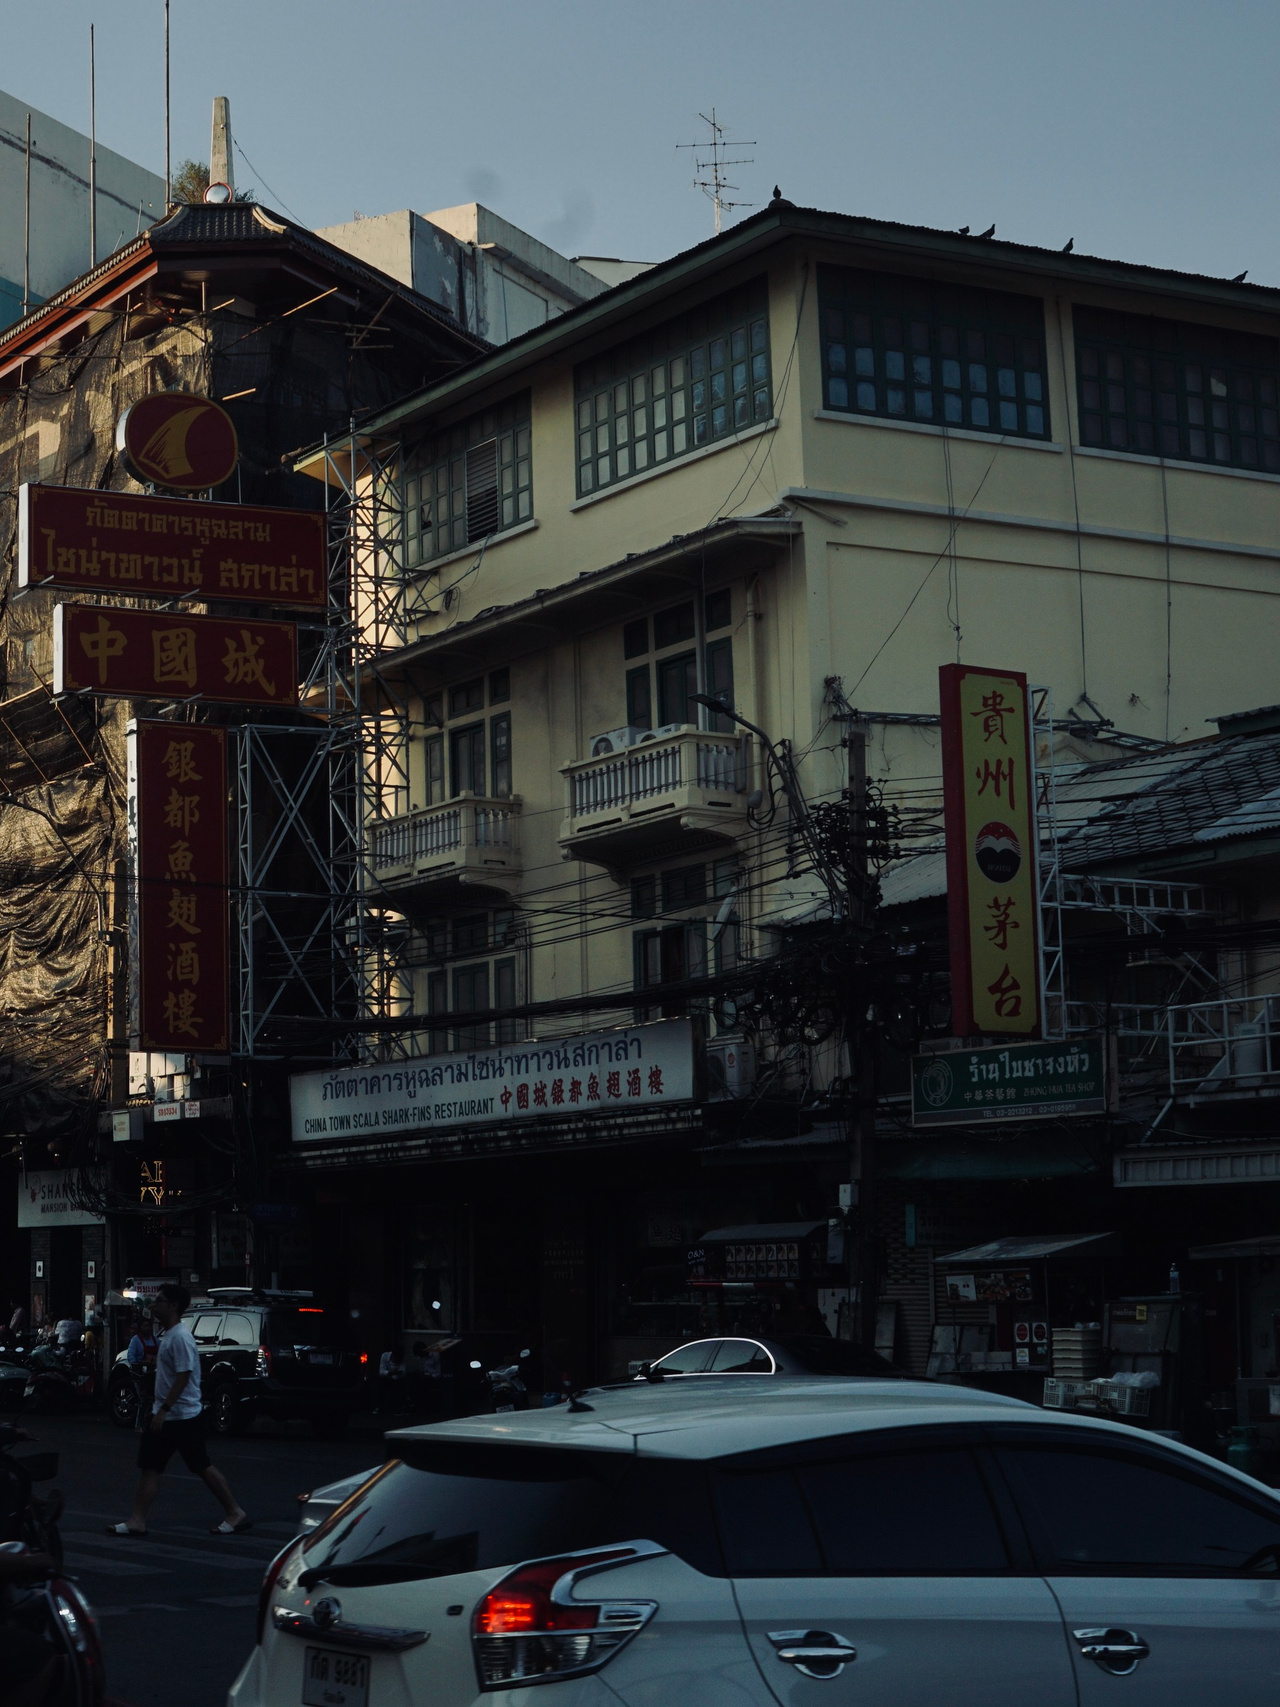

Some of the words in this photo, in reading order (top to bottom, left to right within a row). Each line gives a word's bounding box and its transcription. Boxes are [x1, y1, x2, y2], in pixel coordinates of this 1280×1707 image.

[86, 498, 271, 545] ภัตตาคารหูฉลาม
[219, 555, 315, 594] สกาล่า
[79, 615, 276, 696] 中國城
[970, 690, 1016, 811] 貴州
[161, 740, 204, 1039] 銀都魚翅酒樓
[984, 896, 1022, 1018] 茅台
[500, 1065, 664, 1113] 中國城銀都魚翅酒樓
[1023, 1085, 1047, 1097] ZHONG
[1048, 1083, 1064, 1094] HUA
[1065, 1082, 1077, 1093] TEA
[1077, 1081, 1096, 1092] SHOP
[305, 1118, 327, 1134] CHINA
[329, 1114, 351, 1131] TOWN
[353, 1110, 380, 1128] SCALA
[382, 1105, 431, 1125] SHARK-FINS
[434, 1097, 494, 1120] RESTAURANT
[983, 1110, 994, 1118] TEL
[41, 1202, 67, 1214] MANSION
